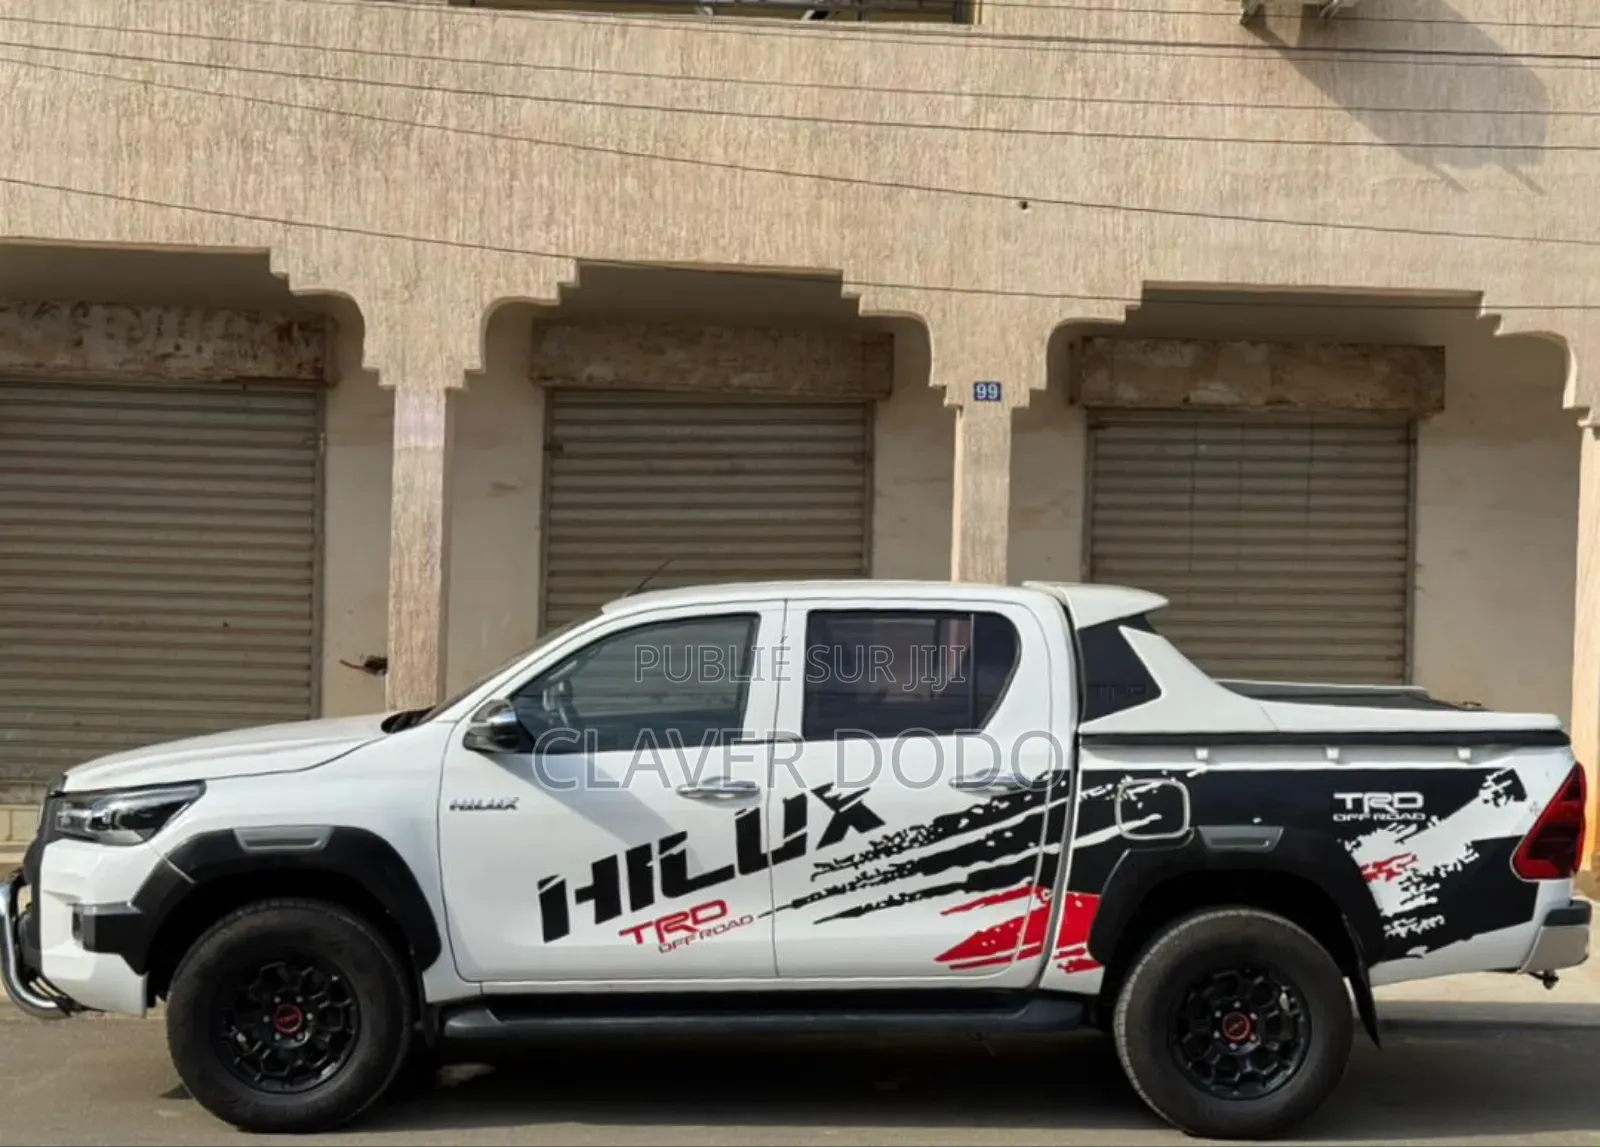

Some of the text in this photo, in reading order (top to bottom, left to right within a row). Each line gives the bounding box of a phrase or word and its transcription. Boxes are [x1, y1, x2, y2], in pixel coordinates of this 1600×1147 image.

[976, 383, 998, 399] 99
[1333, 791, 1424, 814] TRD
[537, 781, 886, 943] HILUX
[618, 899, 728, 945] TRD
[658, 914, 755, 953] OFF ROAD
